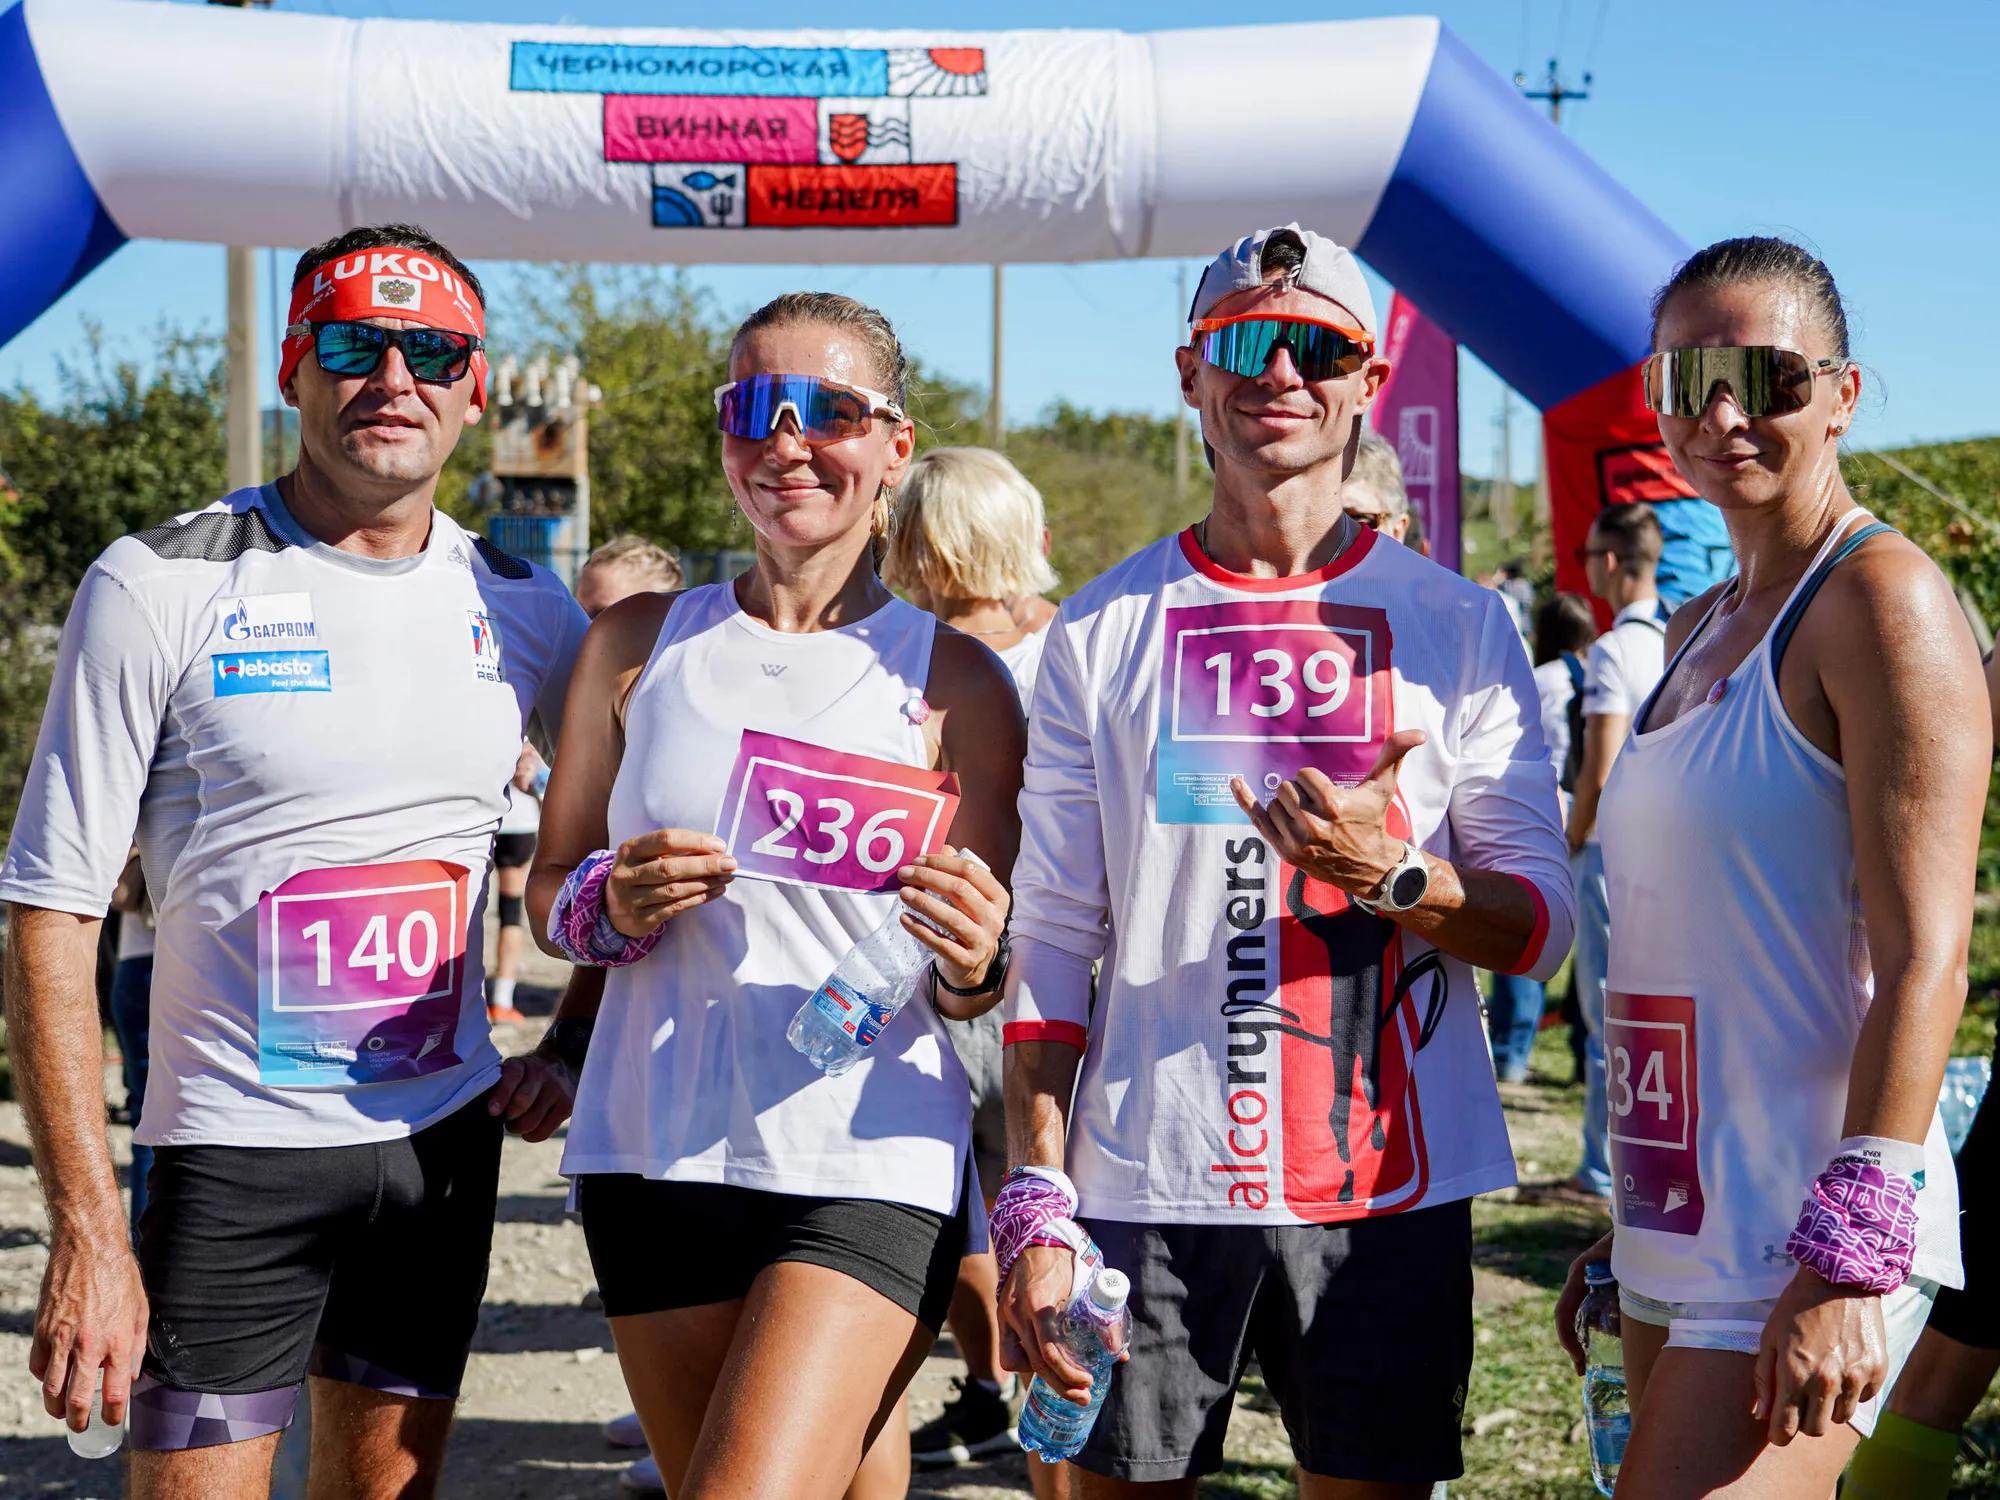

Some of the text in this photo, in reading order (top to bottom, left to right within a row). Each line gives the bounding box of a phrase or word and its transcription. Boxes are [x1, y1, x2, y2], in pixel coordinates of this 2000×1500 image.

[537, 54, 851, 79] ЧЕРНОМОРСКАЯ
[635, 114, 789, 140] ВИННАЯ
[770, 187, 921, 215] НЕДЕЛЯ
[312, 252, 473, 312] LUKOIL
[253, 622, 316, 638] GAZPROM
[217, 658, 312, 680] Webasto
[271, 680, 289, 688] Feel
[1204, 648, 1350, 718] 139
[751, 788, 910, 873] 236
[302, 909, 438, 986] 140
